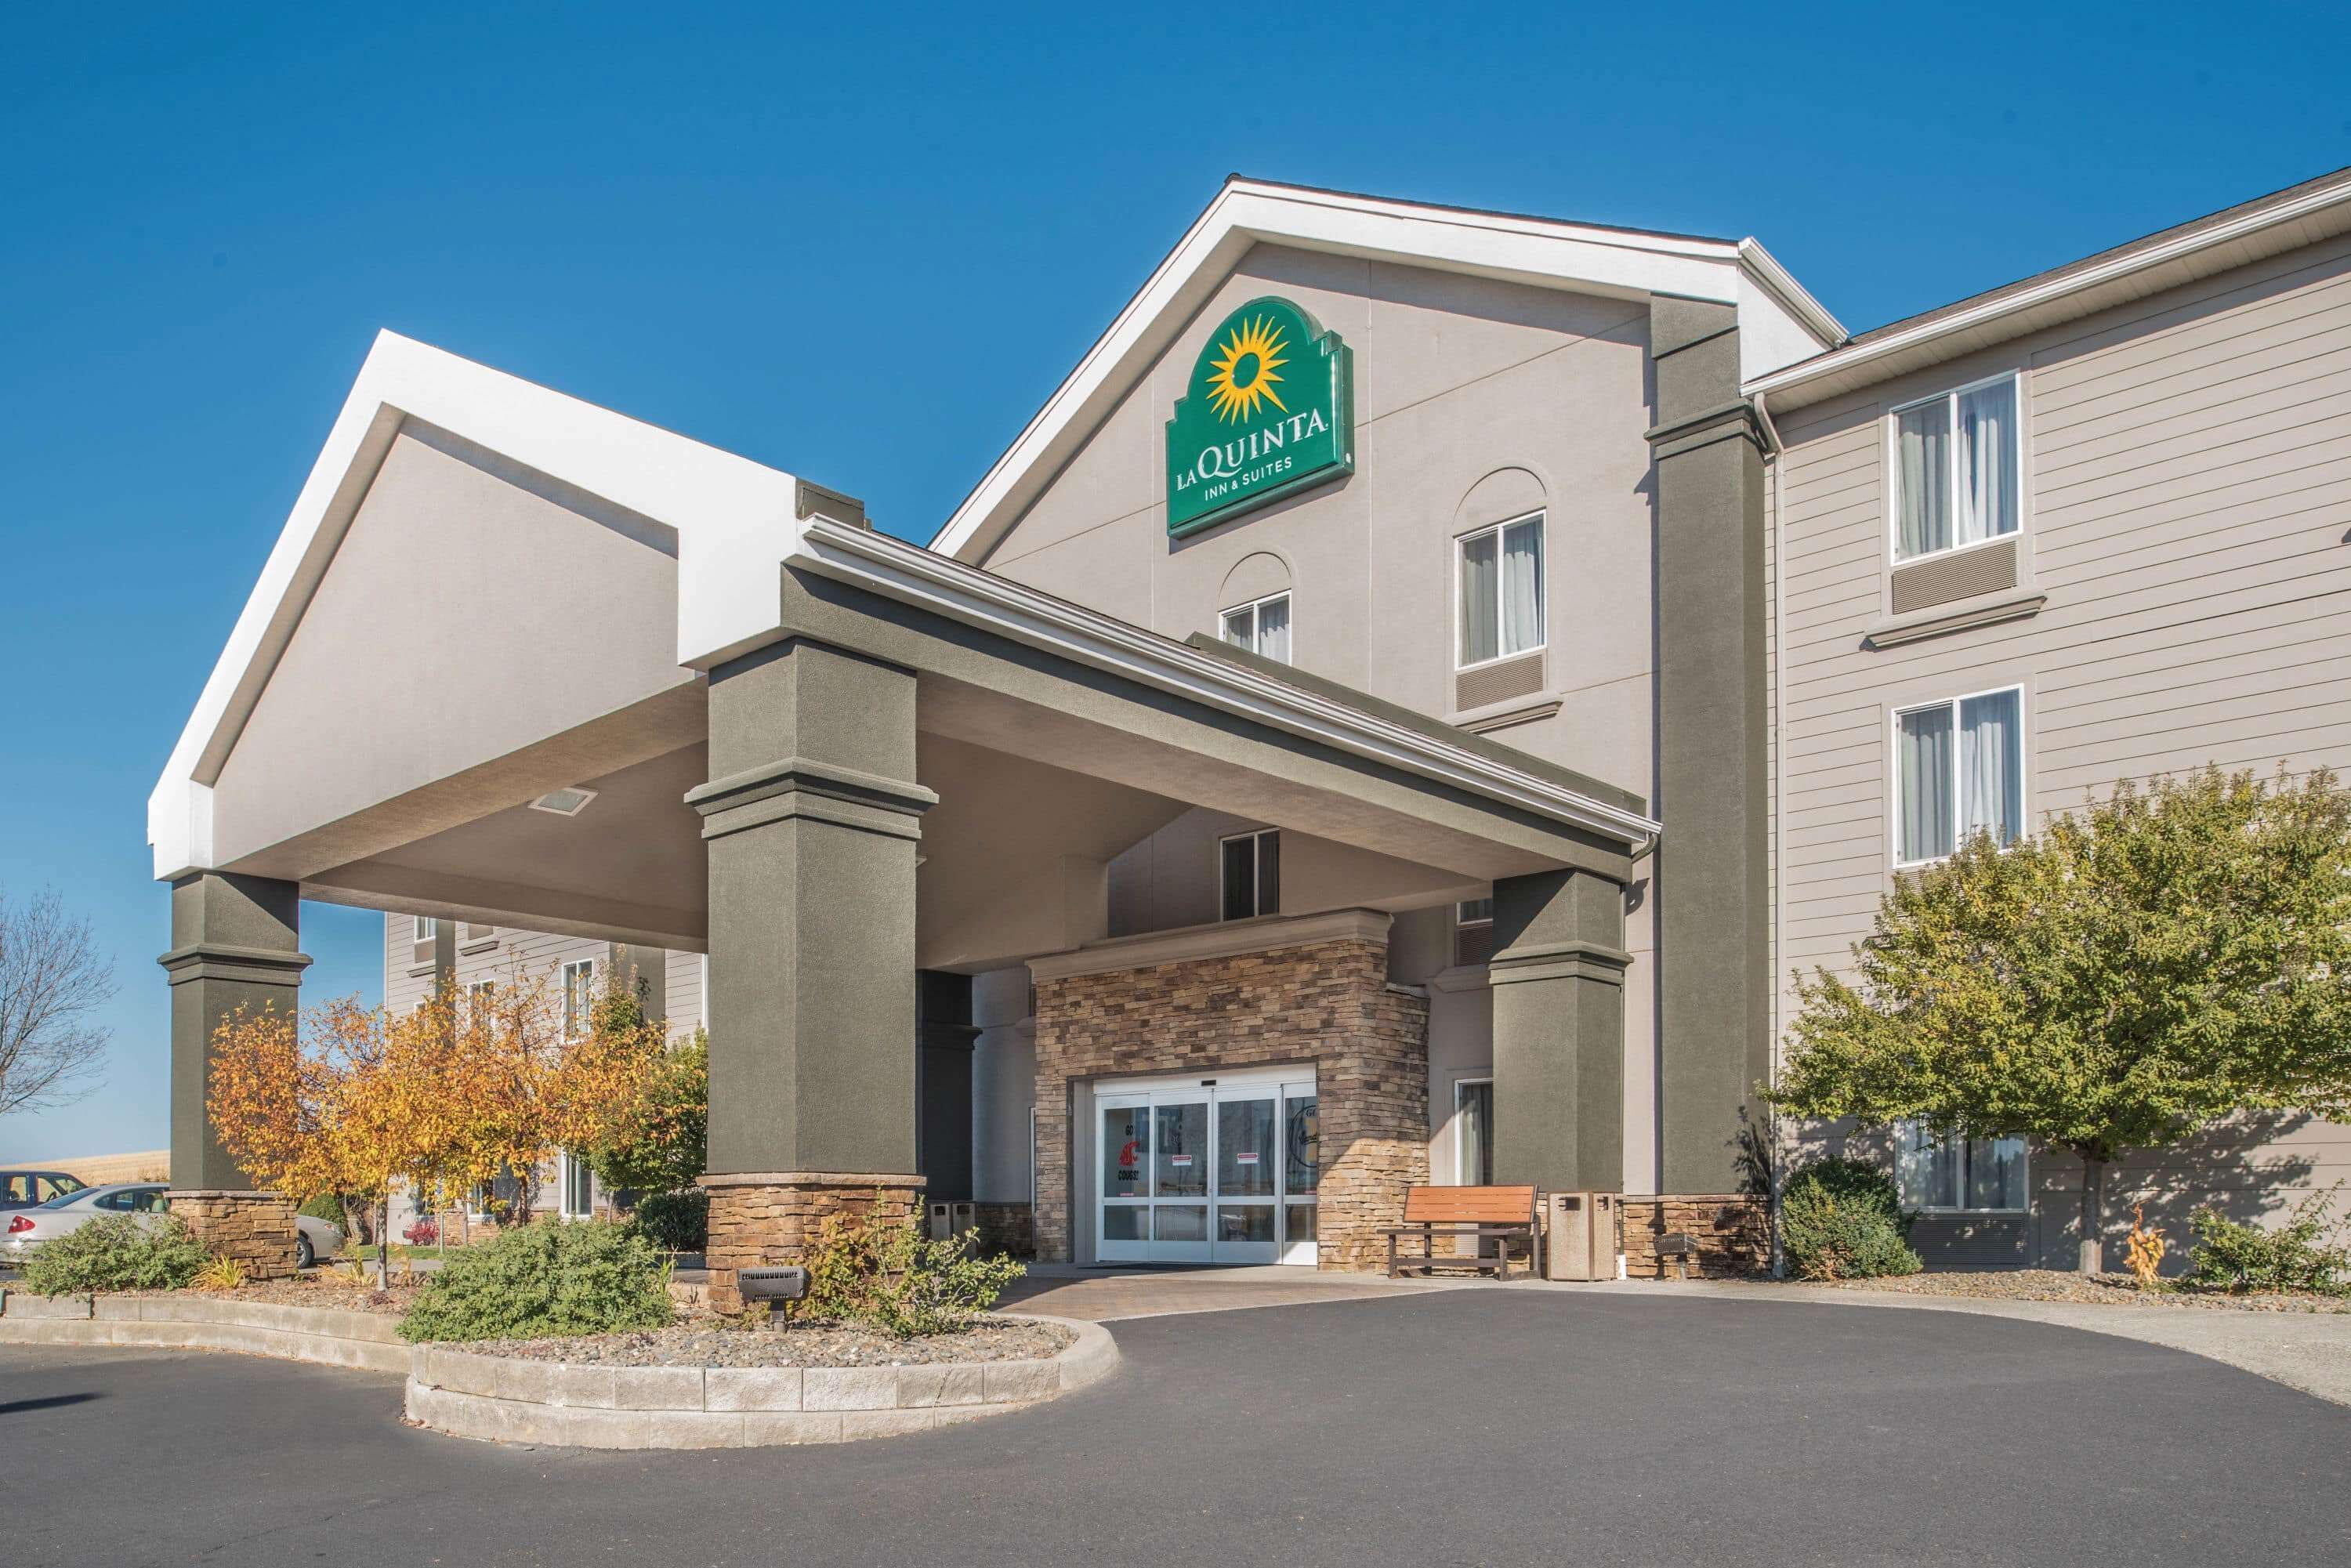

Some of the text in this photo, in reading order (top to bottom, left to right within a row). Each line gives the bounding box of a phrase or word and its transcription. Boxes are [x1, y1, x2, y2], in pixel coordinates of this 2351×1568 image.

[1176, 407, 1328, 491] LA QUINTA
[1204, 456, 1292, 502] INN & SUITES
[1125, 1124, 1134, 1136] GO
